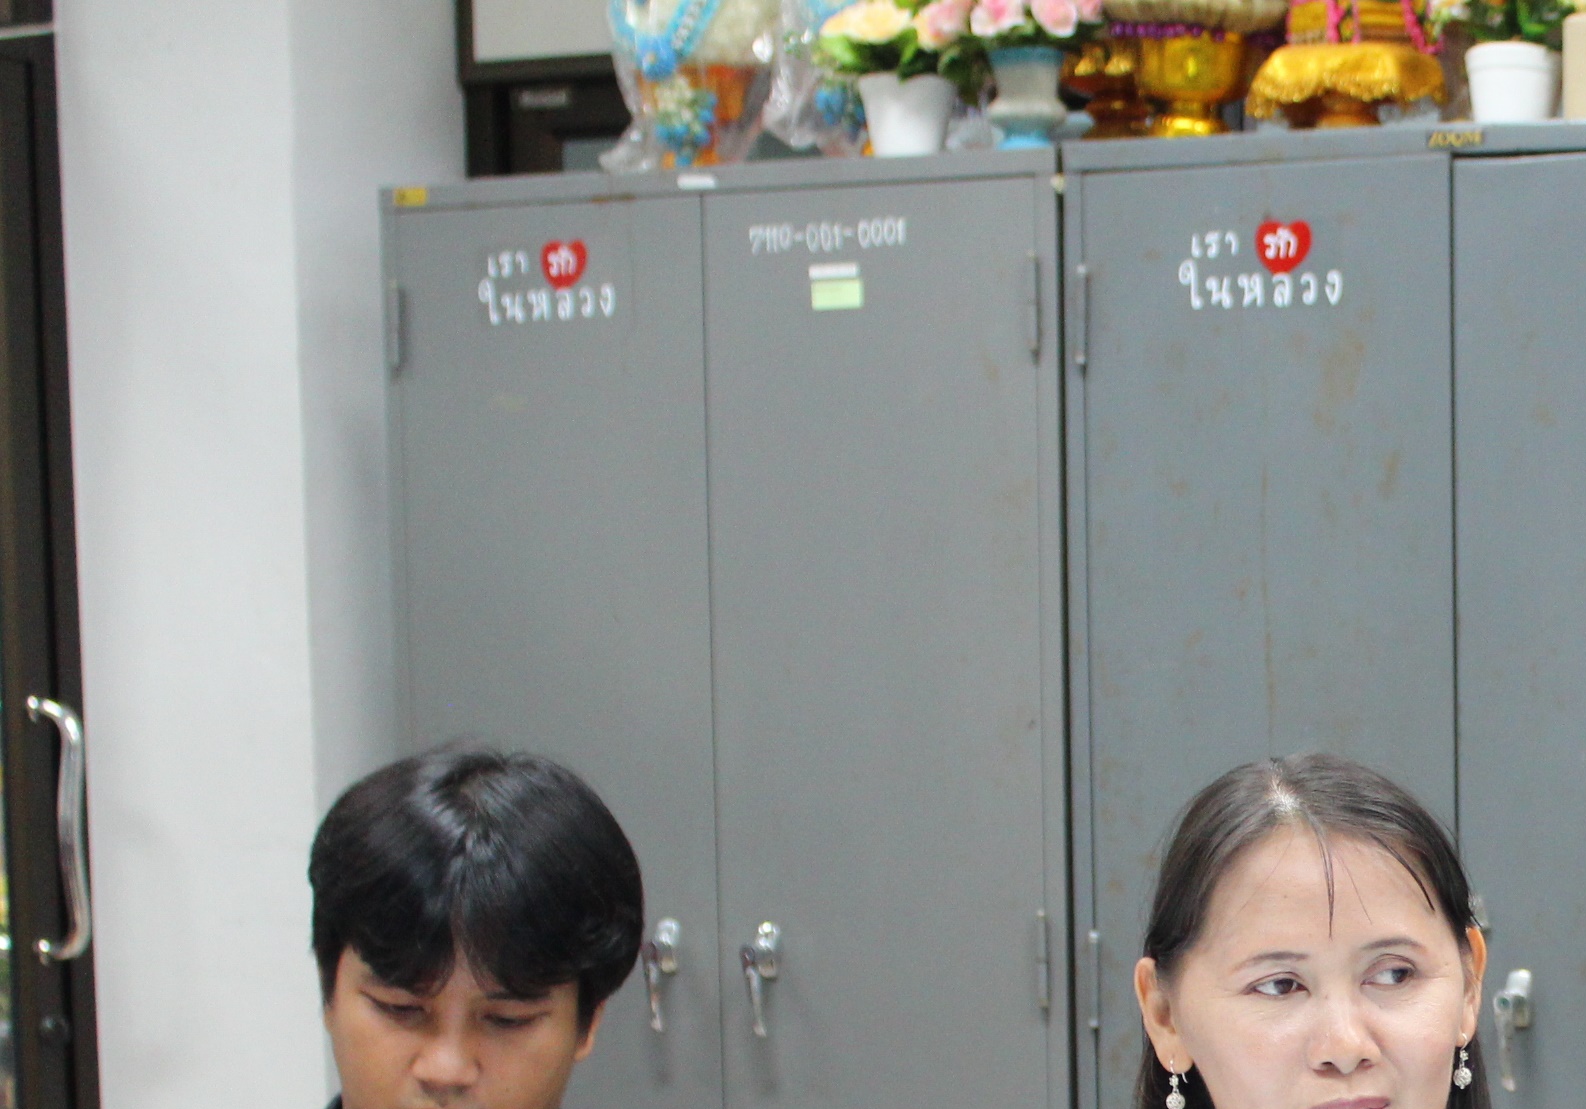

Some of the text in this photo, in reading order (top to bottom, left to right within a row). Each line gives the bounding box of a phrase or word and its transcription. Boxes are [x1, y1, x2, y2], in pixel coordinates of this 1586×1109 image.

[748, 215, 908, 256] 7110-001-0001
[1190, 226, 1298, 259] เรา รัก
[487, 250, 530, 278] เรา
[1178, 258, 1344, 311] ในหลวง
[478, 278, 617, 326] ในหลวง
